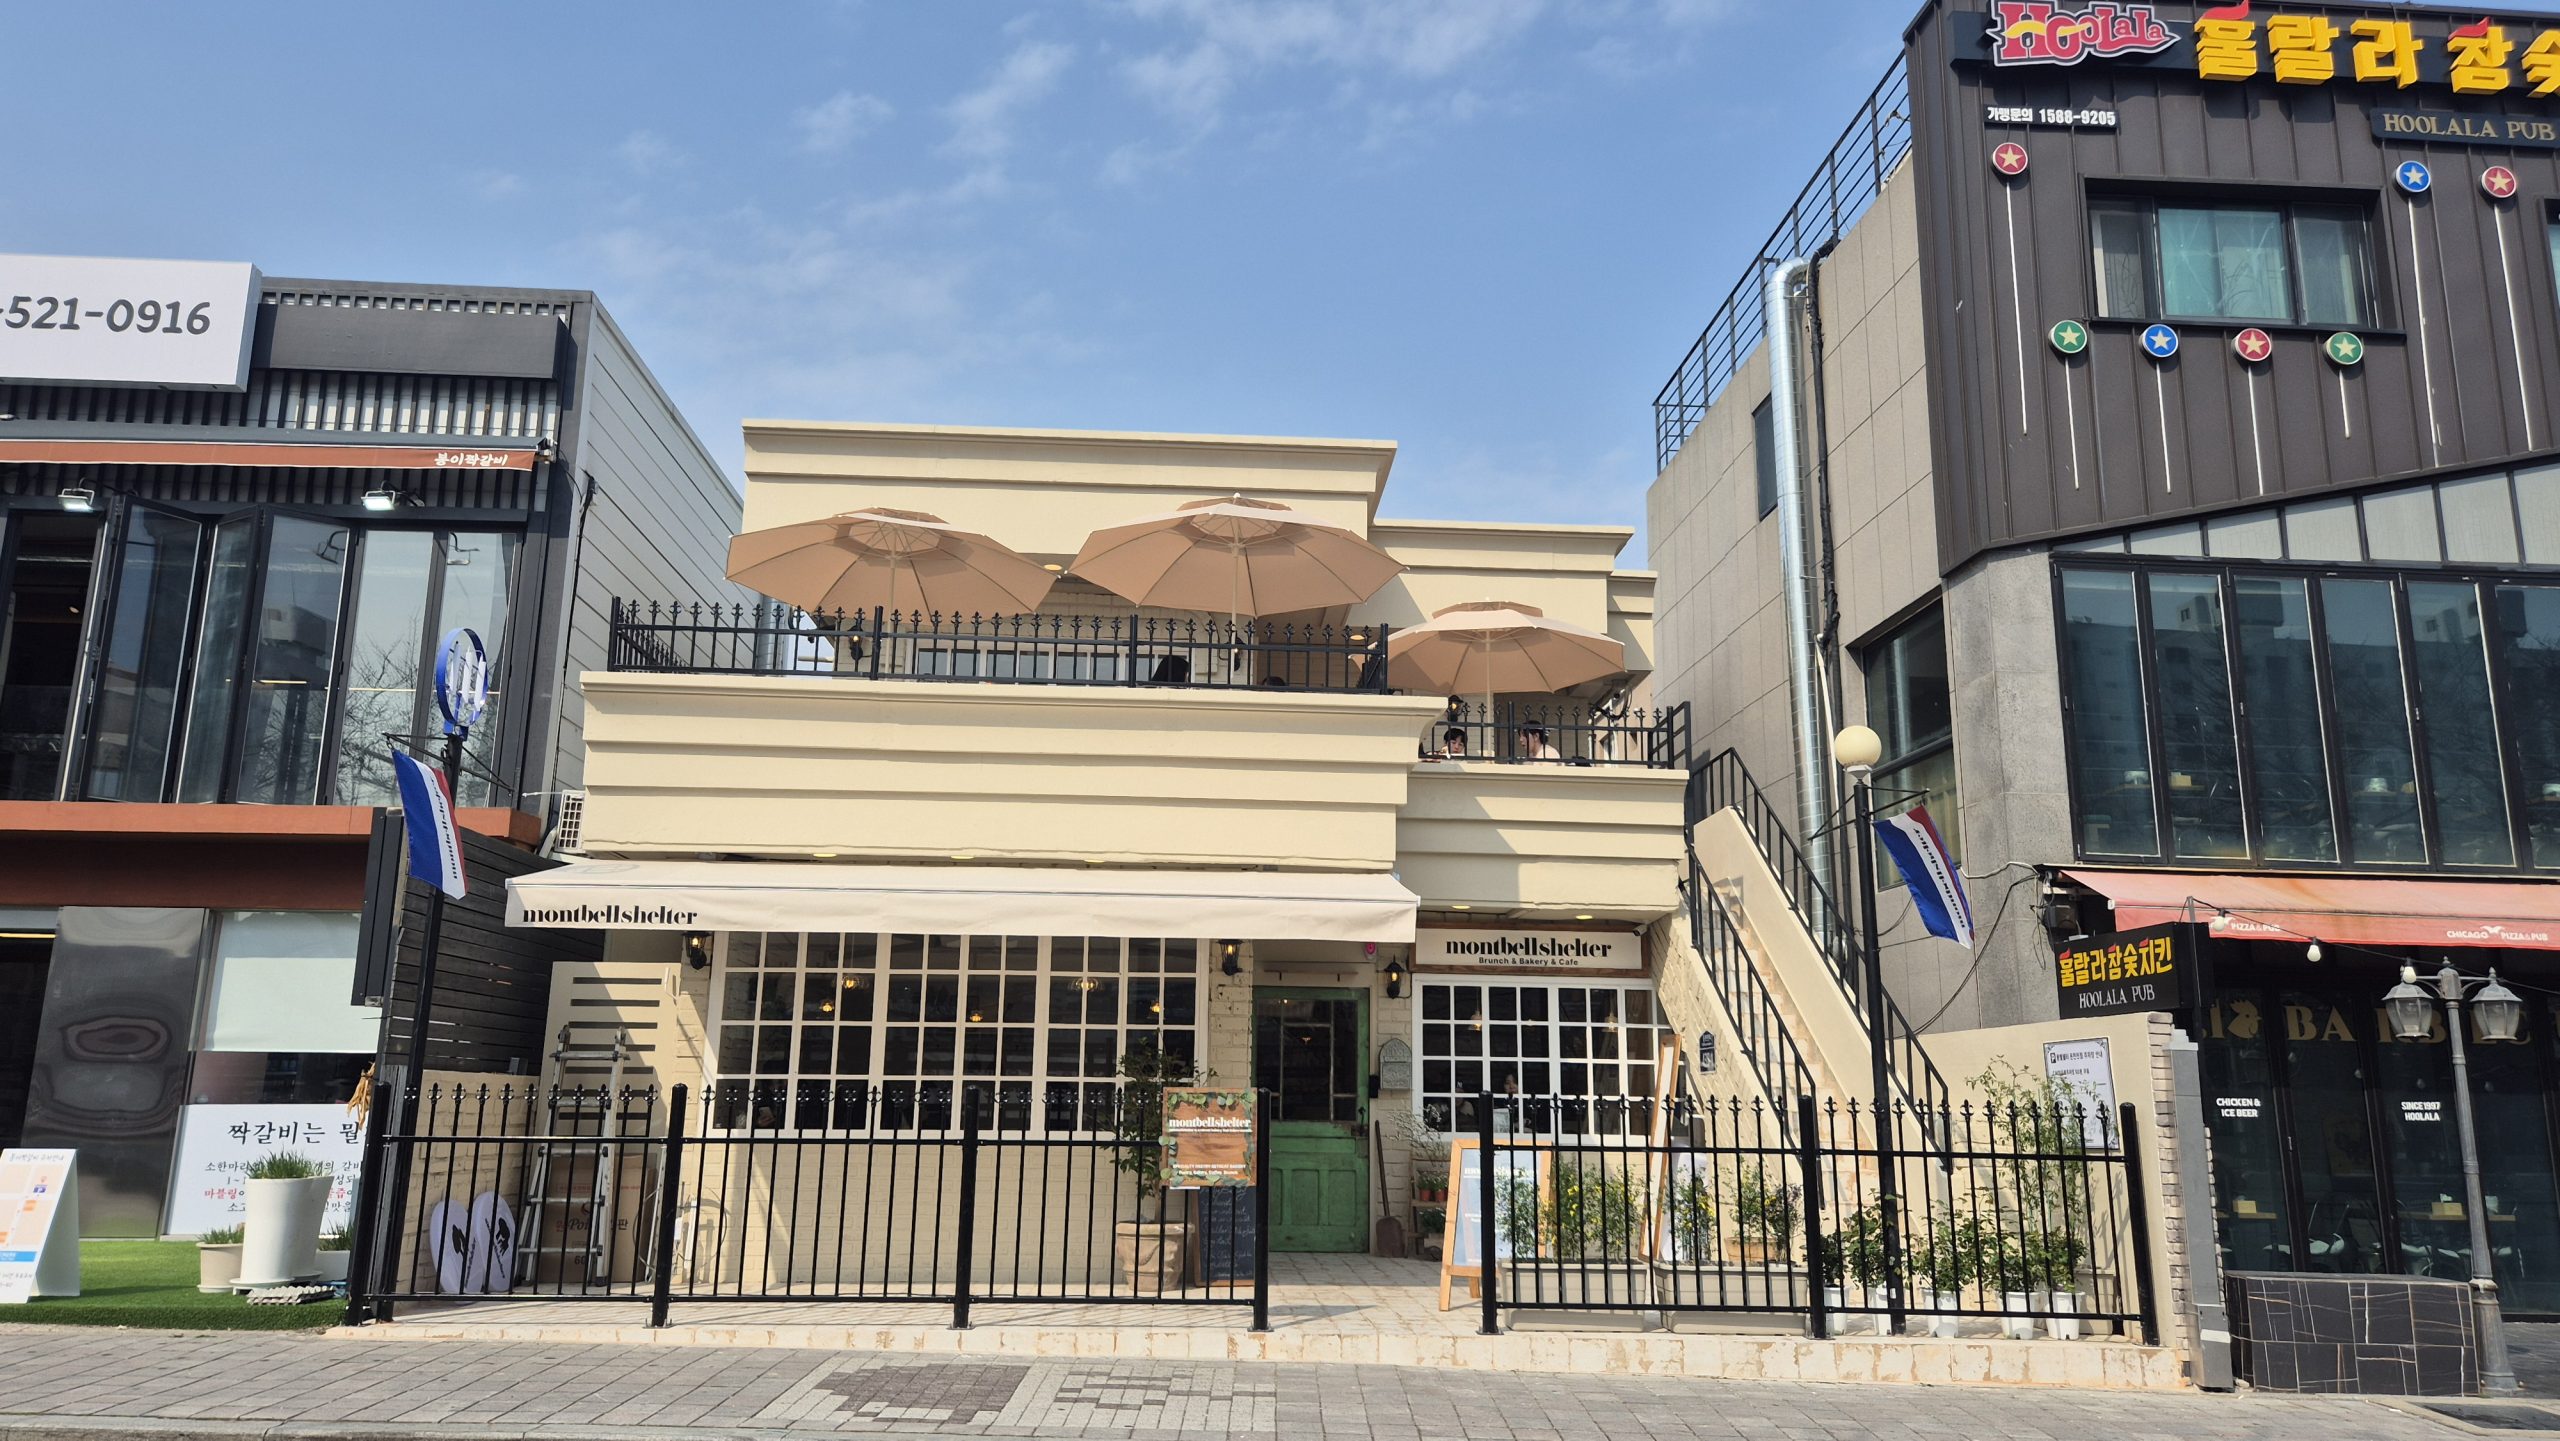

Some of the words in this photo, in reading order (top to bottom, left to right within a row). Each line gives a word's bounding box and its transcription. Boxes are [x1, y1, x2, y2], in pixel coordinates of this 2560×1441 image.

[1987, 106, 2034, 122] 가맹문의
[2039, 108, 2116, 126] 1588-9205
[2382, 113, 2499, 138] HOOLALA
[2506, 121, 2556, 141] PUB
[0, 295, 211, 335] 521-0916
[523, 904, 698, 925] montbellshelter
[2446, 930, 2489, 939] CHICAGO
[1446, 936, 1612, 958] montbellshelter
[1478, 956, 1509, 965] Brunch
[1511, 957, 1517, 965] &
[1519, 957, 1548, 967] Bakery
[1551, 958, 1557, 966] &
[1559, 958, 1579, 966] Cafe
[2079, 988, 2127, 1009] HOOLALA
[2131, 983, 2155, 1002] PUB
[2216, 1097, 2253, 1107] CHICKEN
[2254, 1098, 2261, 1107] &
[2221, 1109, 2235, 1117] ICE
[2236, 1109, 2258, 1118] BEER
[2404, 1112, 2440, 1121] HOOLALA
[227, 1121, 326, 1145] 짝갈비는
